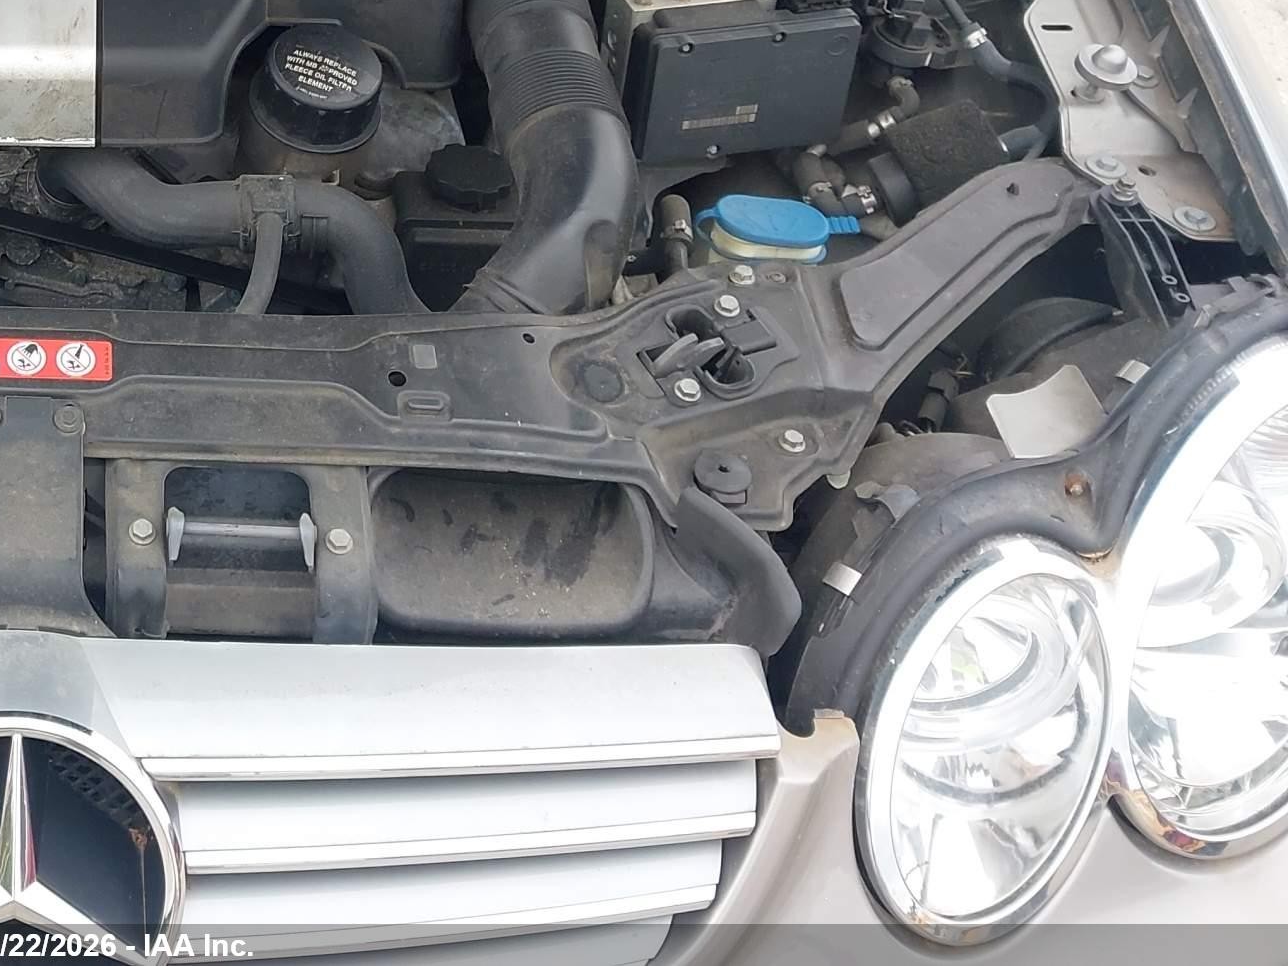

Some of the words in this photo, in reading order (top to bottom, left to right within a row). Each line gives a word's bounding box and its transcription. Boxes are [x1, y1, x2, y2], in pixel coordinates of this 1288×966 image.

[287, 55, 305, 66] WITH
[293, 50, 323, 62] ALWAYS
[324, 58, 357, 77] REPLACE
[285, 63, 314, 76] FLEECE
[315, 72, 327, 81] OIL
[328, 77, 352, 92] FILTER
[298, 75, 333, 92] ELEMENT
